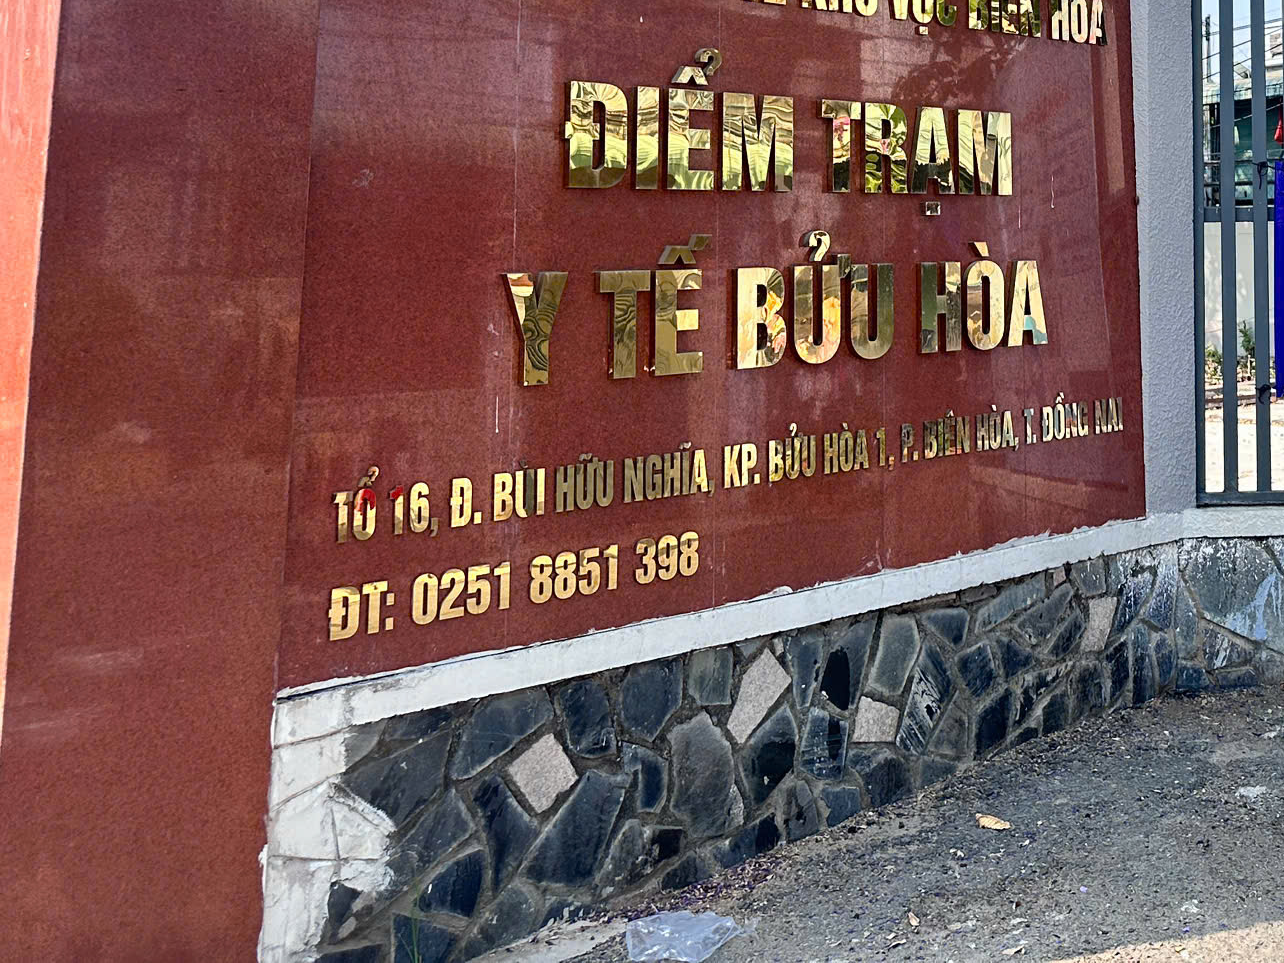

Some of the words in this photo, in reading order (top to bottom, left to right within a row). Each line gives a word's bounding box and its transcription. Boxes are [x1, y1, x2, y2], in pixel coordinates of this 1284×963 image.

[565, 48, 794, 192] ĐIỂM
[822, 99, 1012, 215] TRẠM
[502, 271, 569, 386] Y
[595, 234, 712, 379] TẾ
[735, 230, 894, 370] BỬU
[919, 241, 1048, 354] HÒA
[333, 466, 380, 543] TỔ
[390, 482, 439, 537] 16,
[450, 477, 482, 528] Đ.
[493, 460, 546, 521] BÙI
[555, 453, 614, 513] HỮU
[624, 441, 716, 503] NGHĨA,
[723, 445, 761, 489] KP.
[768, 423, 816, 483] BỬU
[824, 423, 869, 474] HÒA
[876, 428, 895, 470] 1,
[901, 423, 919, 463] P.
[924, 410, 970, 459] BIÊN
[976, 405, 1018, 452] HÒA,
[1023, 408, 1037, 444] T.
[1042, 392, 1089, 442] ĐỒNG
[1093, 397, 1123, 434] NAI
[328, 580, 395, 641] ĐT:
[412, 561, 511, 625] 0251
[529, 544, 618, 604] 8851
[635, 532, 700, 584] 398
